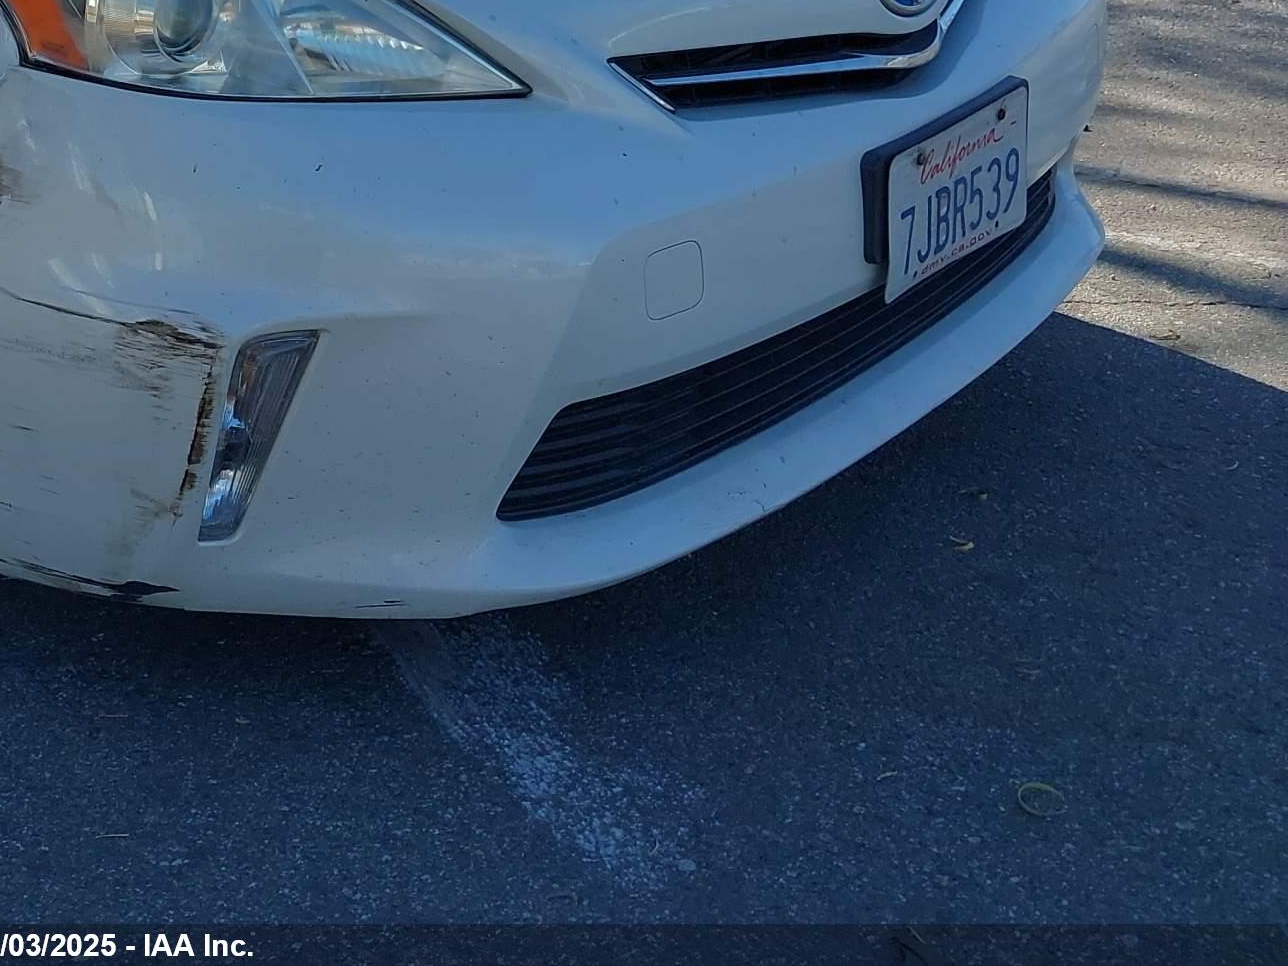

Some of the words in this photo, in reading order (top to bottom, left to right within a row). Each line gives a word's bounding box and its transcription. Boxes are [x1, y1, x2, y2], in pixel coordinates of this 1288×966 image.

[920, 128, 1004, 185] California
[900, 148, 1020, 276] 7JBR539
[920, 228, 993, 276] dmv.ca.gov
